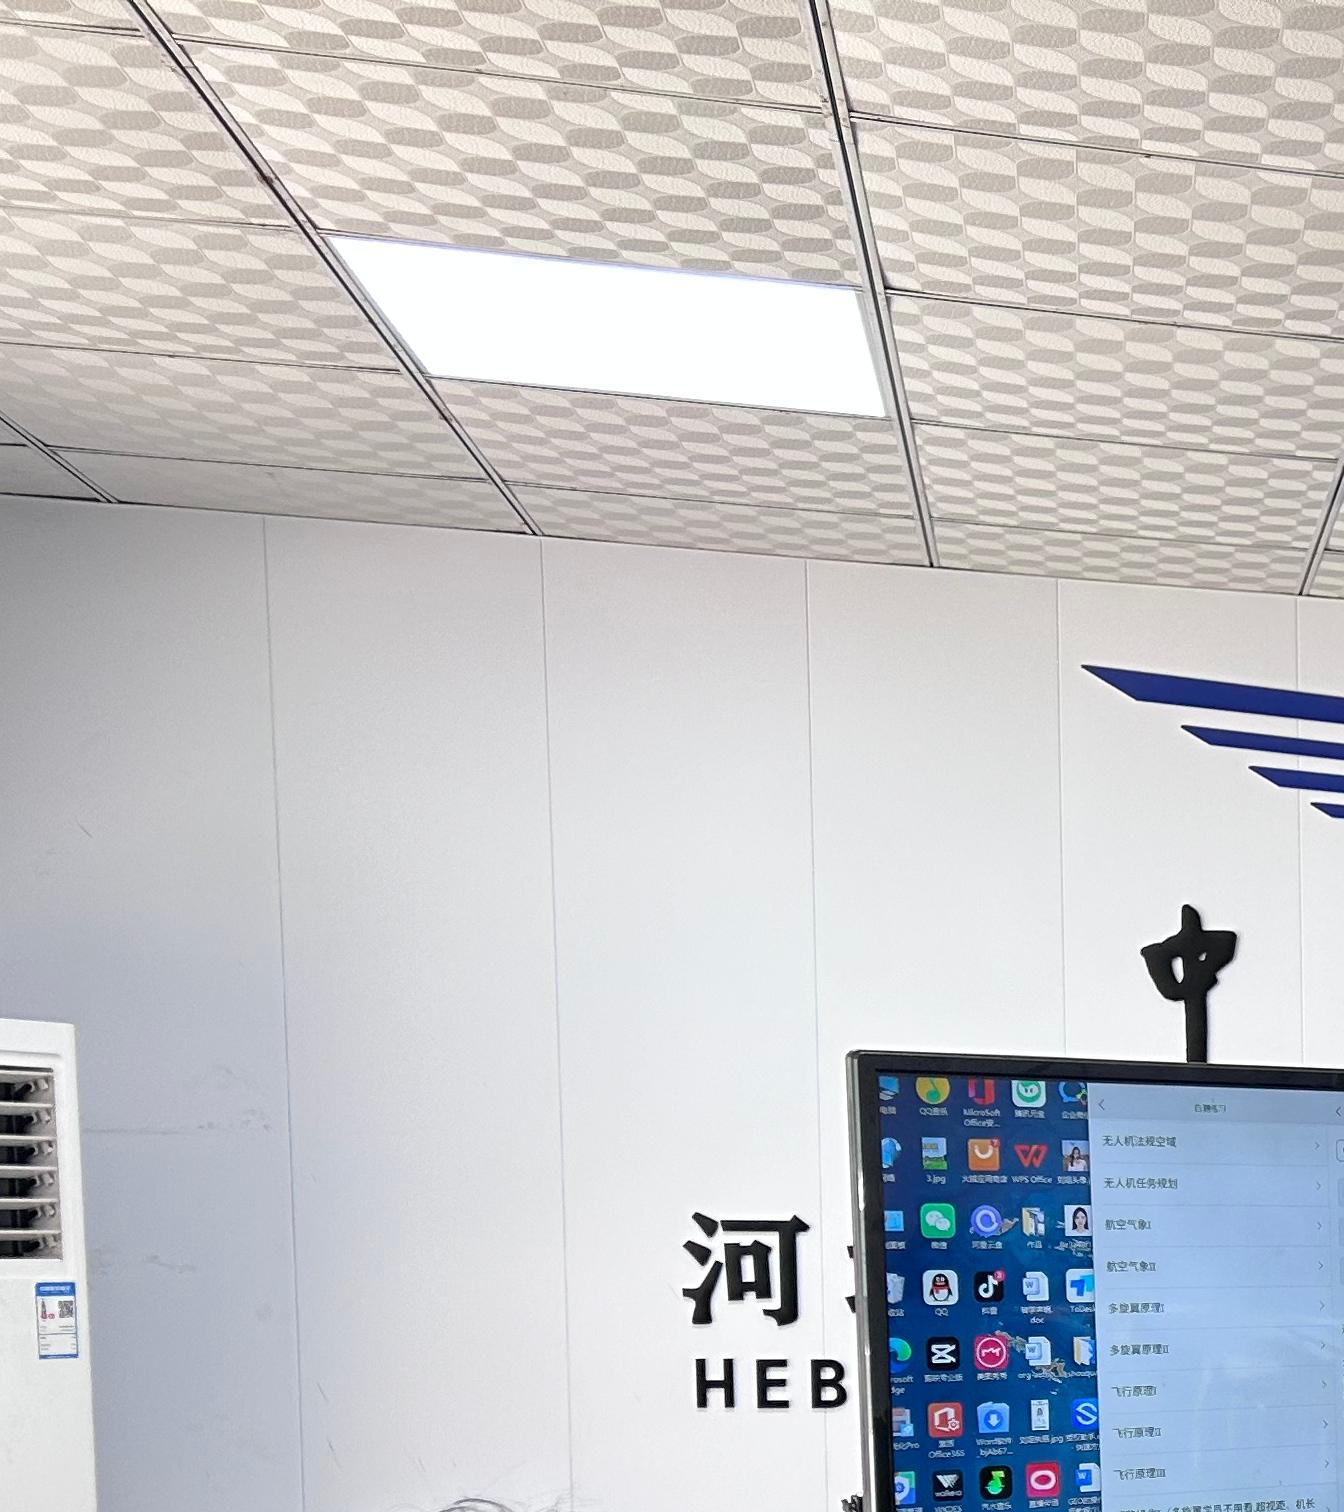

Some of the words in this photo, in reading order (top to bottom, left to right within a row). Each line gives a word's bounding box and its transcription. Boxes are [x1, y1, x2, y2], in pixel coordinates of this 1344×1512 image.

[1102, 1136, 1177, 1148] 无人机法规空域
[1103, 1178, 1178, 1190] 无人机任务规划
[682, 1211, 856, 1326] 河
